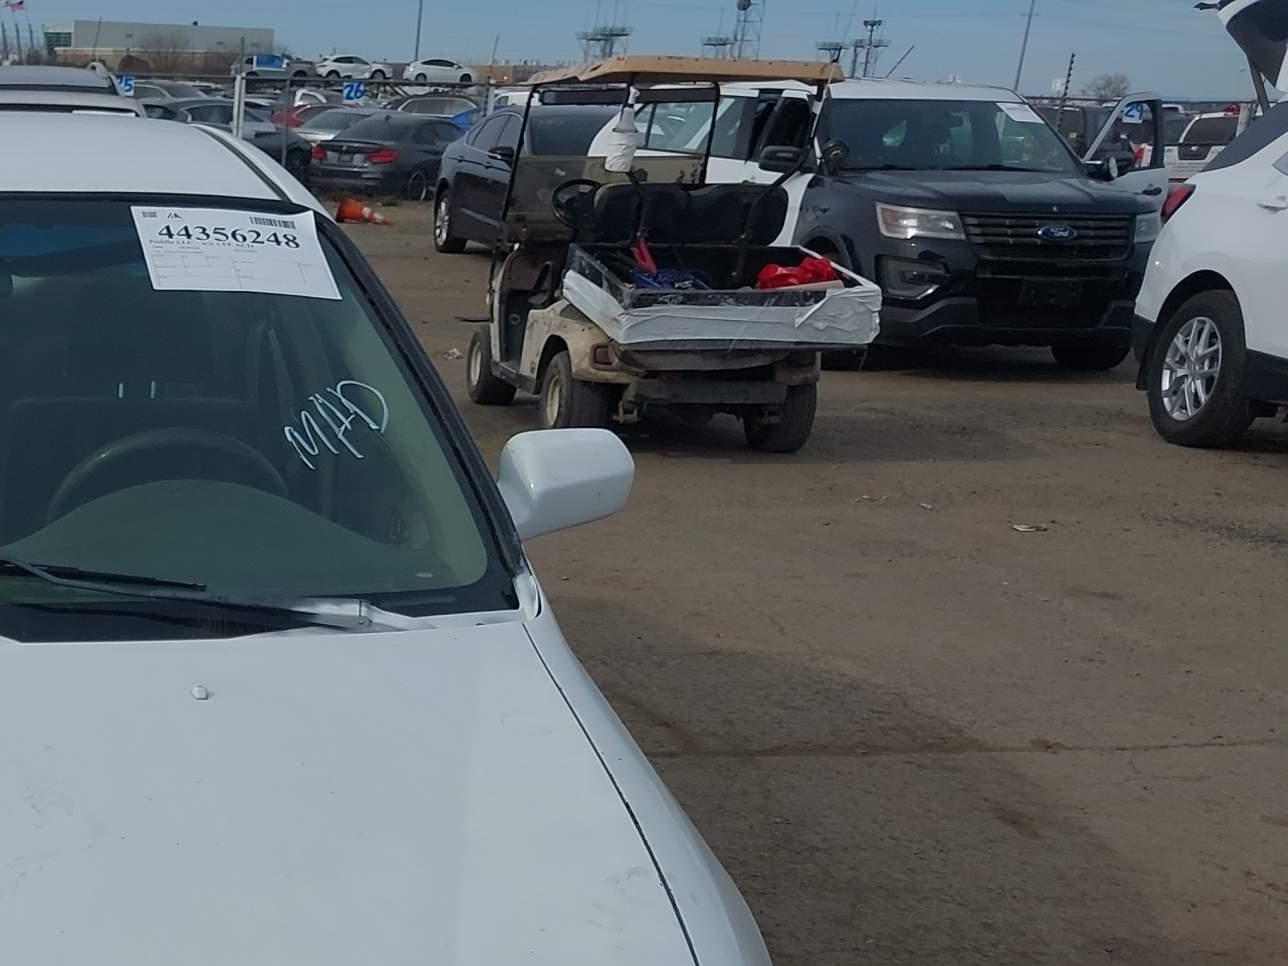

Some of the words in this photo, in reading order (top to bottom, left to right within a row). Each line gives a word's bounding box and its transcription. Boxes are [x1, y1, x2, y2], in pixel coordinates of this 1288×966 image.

[343, 82, 364, 100] 26
[1124, 102, 1144, 120] 29
[158, 224, 300, 249] 44356248
[284, 380, 389, 469] MAD
